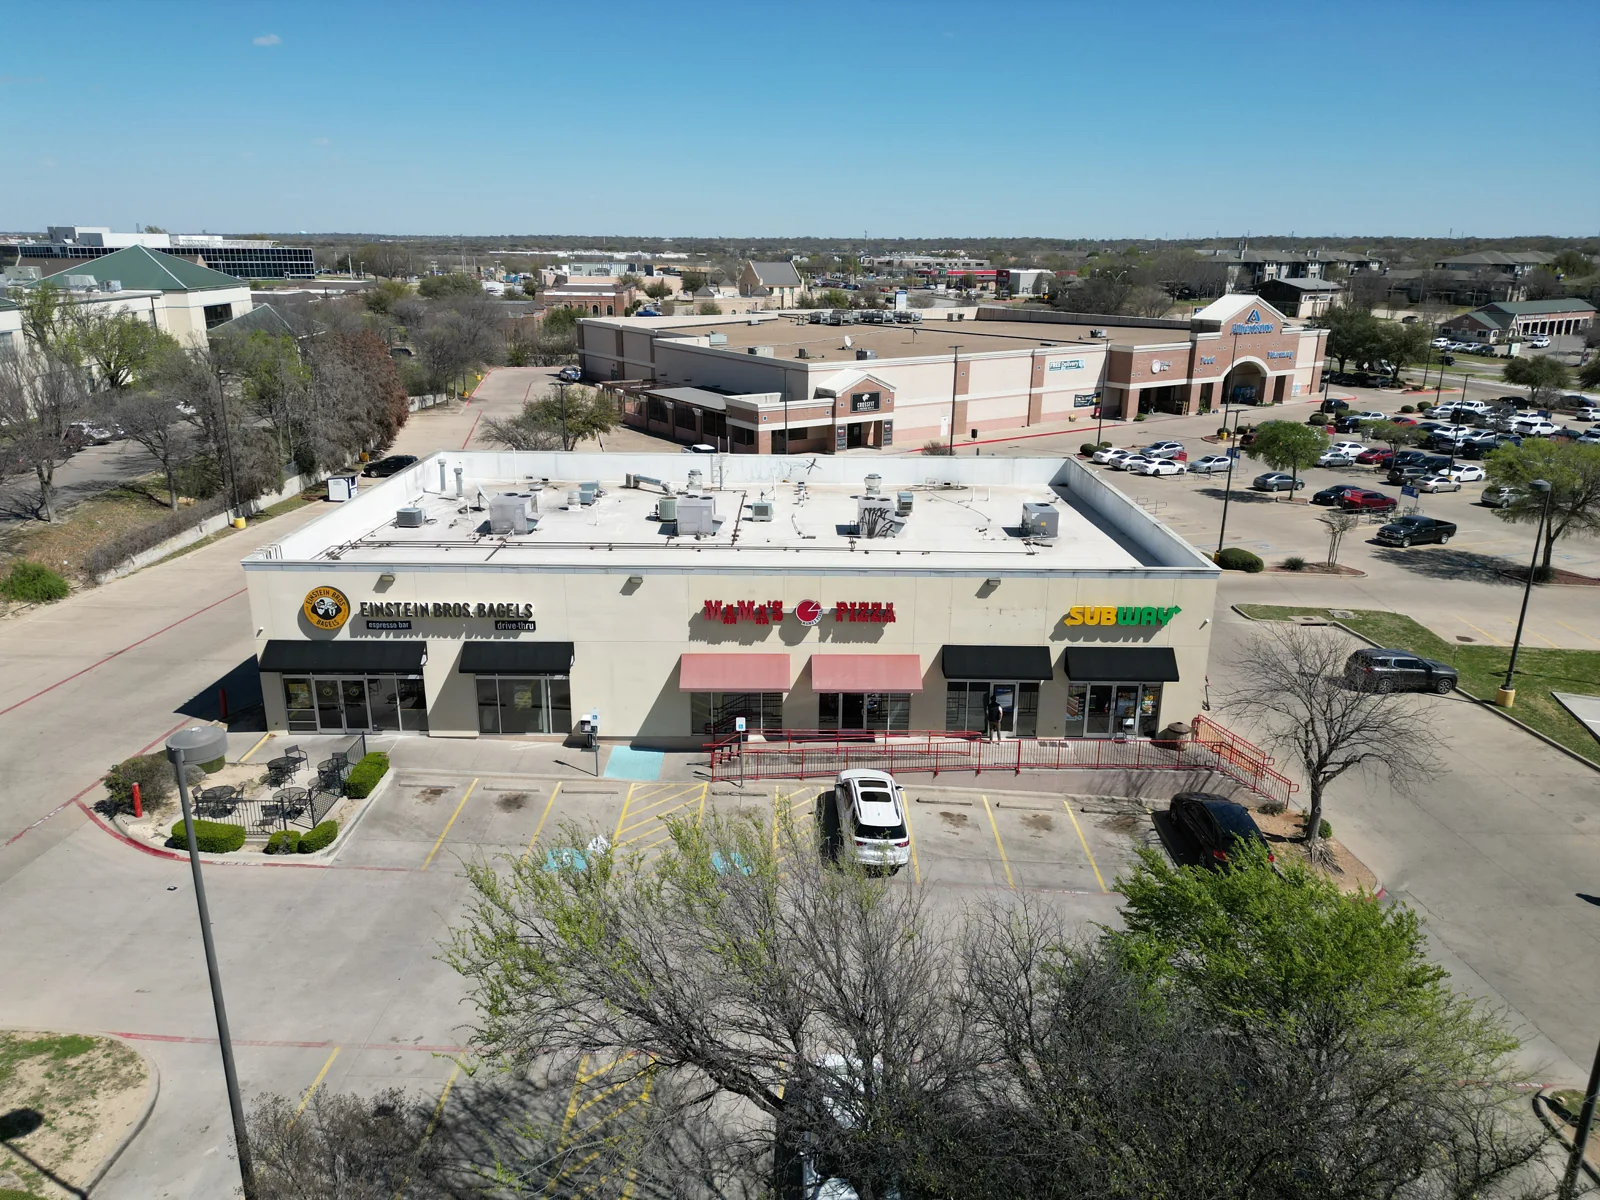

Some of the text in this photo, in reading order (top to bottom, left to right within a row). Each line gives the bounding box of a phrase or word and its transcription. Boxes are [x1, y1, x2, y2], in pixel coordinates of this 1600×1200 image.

[306, 589, 346, 607] EINSTEIN BROS
[359, 601, 431, 618] EINSTEIN
[476, 602, 534, 619] BAGELS
[704, 599, 784, 625] MAMA'S
[835, 601, 896, 623] PIZZA
[1063, 605, 1182, 627] SUBWAY
[316, 619, 340, 628] BAGELS
[368, 621, 409, 630] espresso bar
[497, 621, 534, 631] drive-thru
